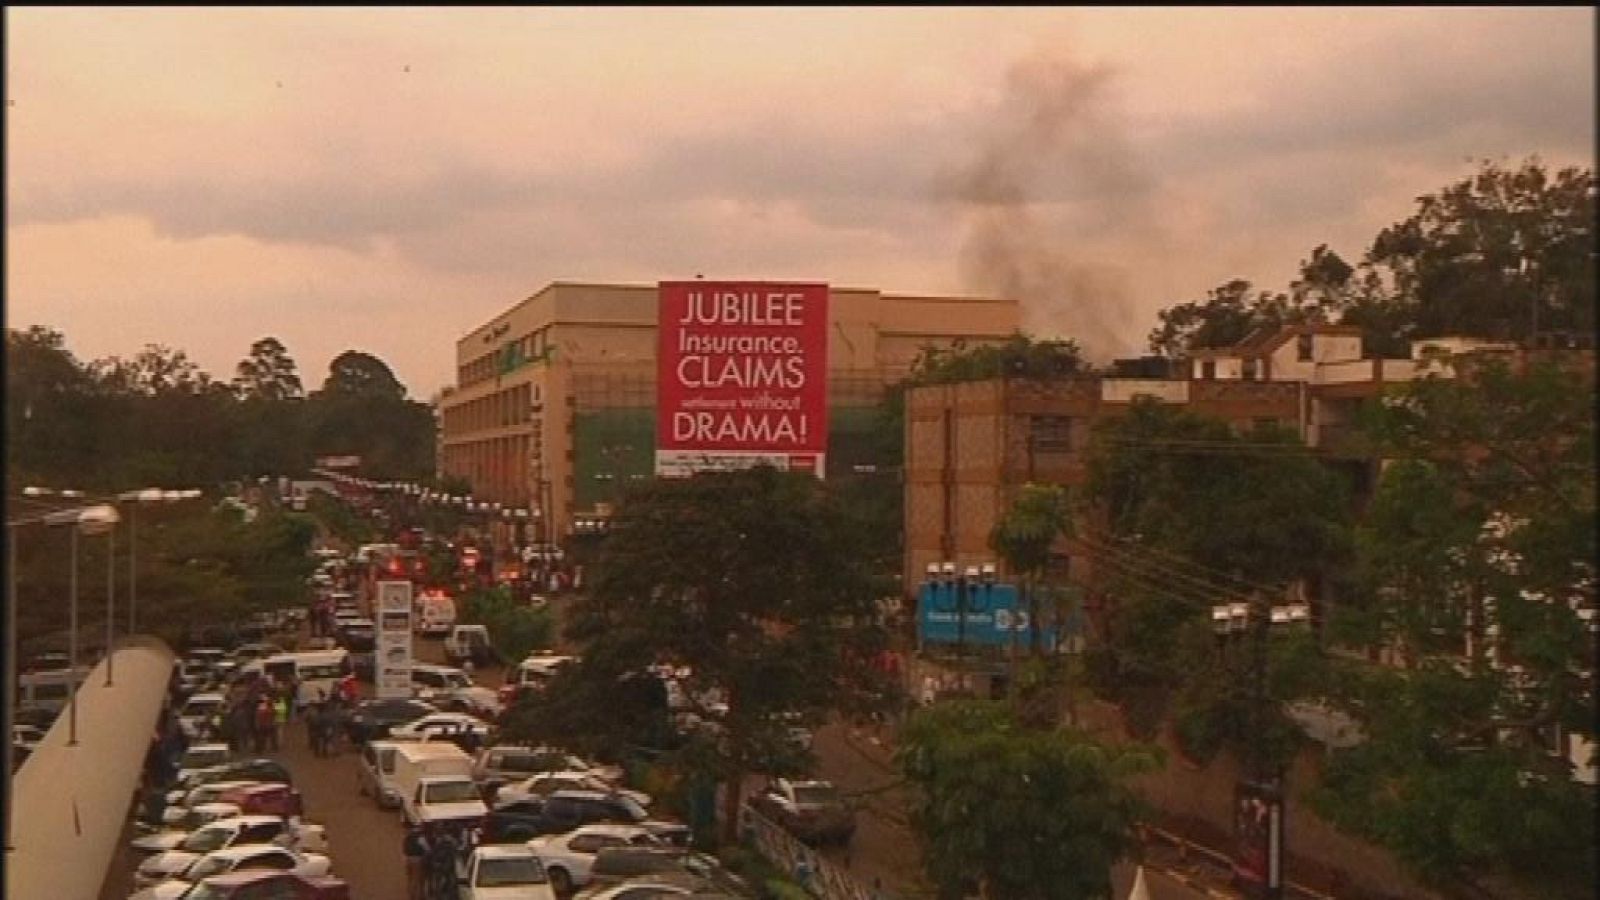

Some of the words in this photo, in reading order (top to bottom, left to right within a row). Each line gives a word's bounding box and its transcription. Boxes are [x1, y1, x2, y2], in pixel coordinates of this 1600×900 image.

[679, 292, 804, 325] JUBILEE
[677, 355, 805, 388] CLAIMS
[740, 391, 800, 409] without
[674, 412, 807, 443] DRAMA!
